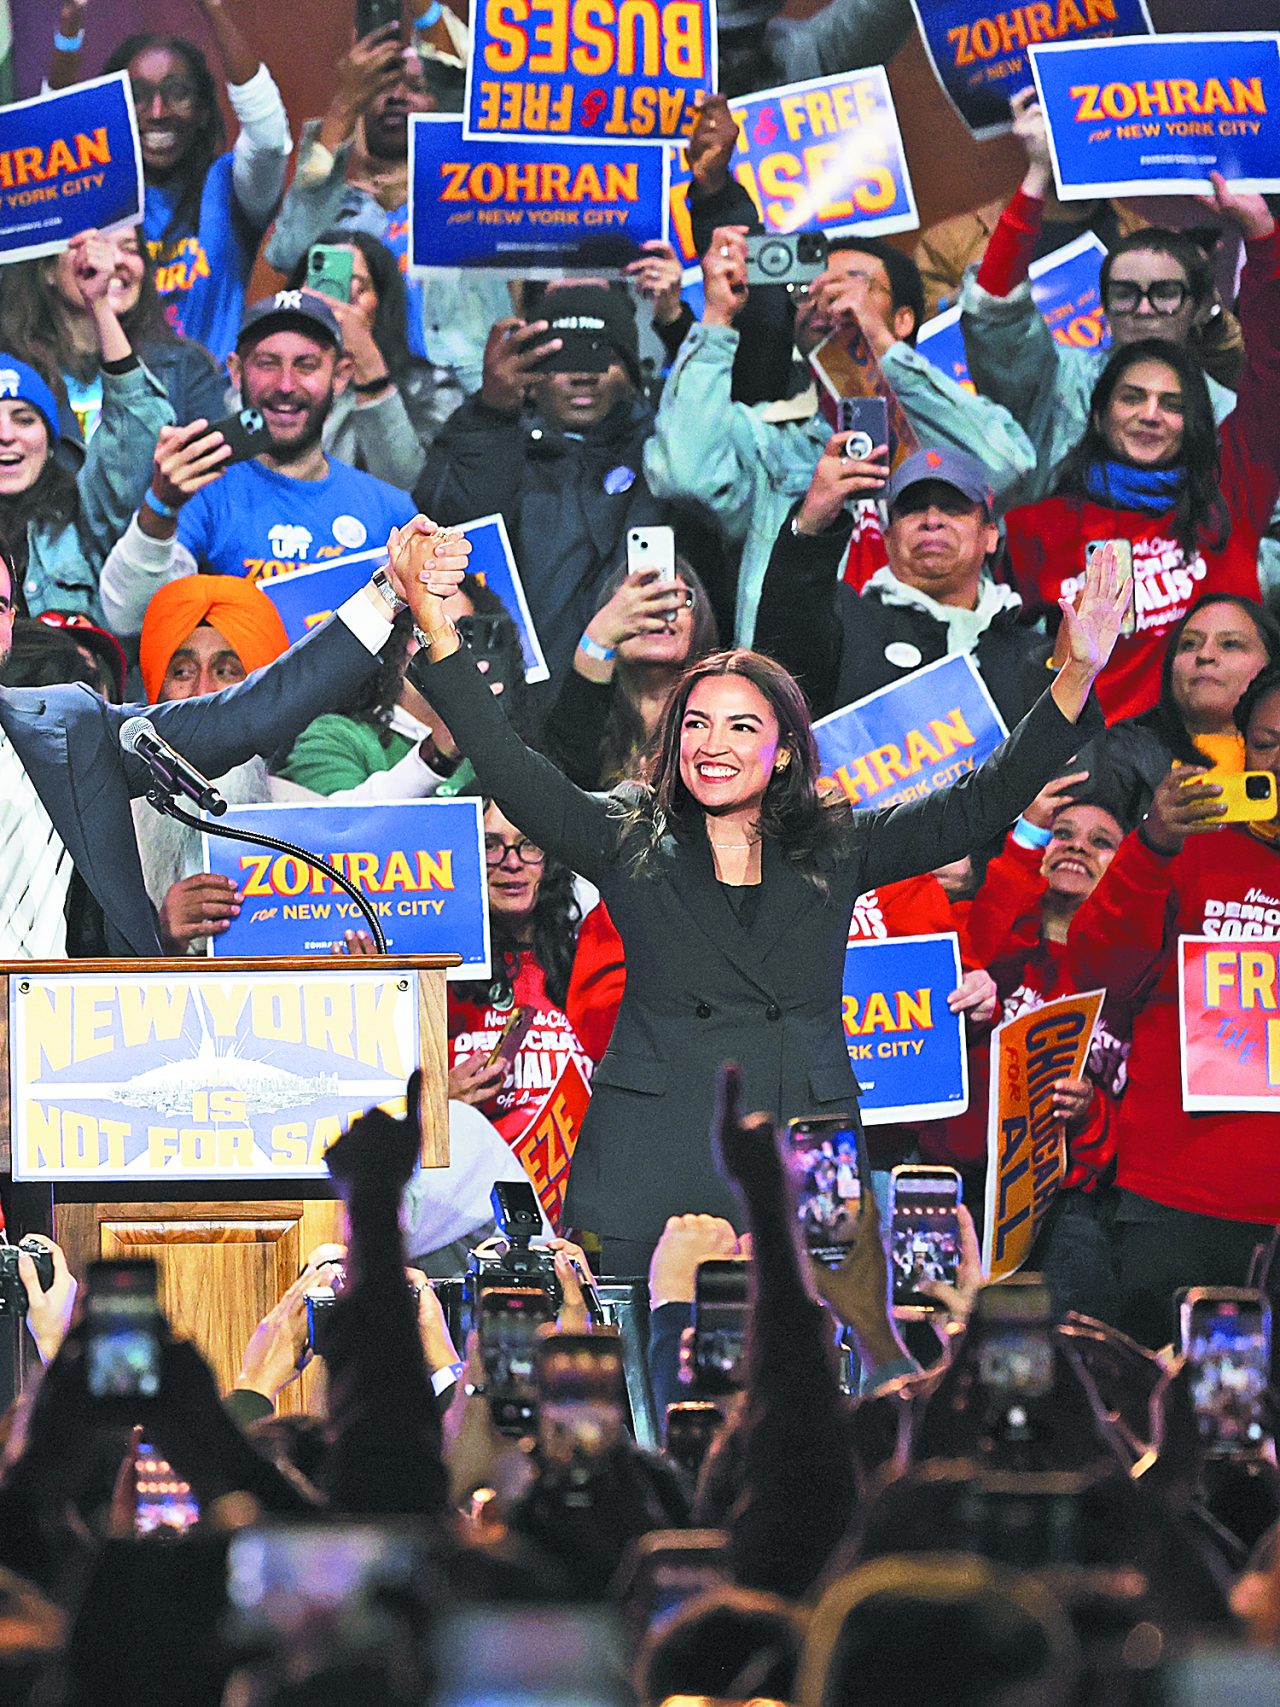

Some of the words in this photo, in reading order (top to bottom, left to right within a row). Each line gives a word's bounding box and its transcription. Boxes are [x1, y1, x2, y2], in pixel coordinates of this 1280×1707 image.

[483, 0, 706, 79] BUSES
[947, 0, 1119, 67] ZOHRAN
[478, 80, 574, 132] FREE
[581, 88, 609, 127] &
[605, 84, 707, 136] FAST
[753, 107, 779, 144] &
[780, 79, 877, 141] FREE
[1070, 77, 1268, 122] ZOHRAN
[1117, 124, 1161, 140] NEW
[1165, 121, 1215, 138] YORK
[1218, 121, 1262, 136] CITY
[7, 186, 58, 207] YORK
[61, 173, 106, 197] CITY
[438, 162, 640, 203] ZOHRAN
[478, 210, 524, 224] NEW
[527, 209, 580, 224] YORK
[583, 209, 630, 225] CITY
[815, 707, 977, 806] HRAN
[932, 756, 976, 787] CITY
[239, 849, 455, 897] ZOHRAN
[250, 907, 277, 924] FOR
[282, 903, 336, 920] NEW
[397, 900, 445, 916] CITY
[1204, 951, 1280, 1011] FR
[26, 985, 193, 1084] NEW
[200, 983, 407, 1080] YORK
[877, 1038, 925, 1059] CITY
[1216, 1018, 1258, 1064] THE
[1006, 1045, 1022, 1101] FOR
[193, 1090, 246, 1123] IS
[27, 1098, 131, 1169] NOT
[149, 1127, 255, 1168] FOR
[995, 1115, 1032, 1262] ALL
